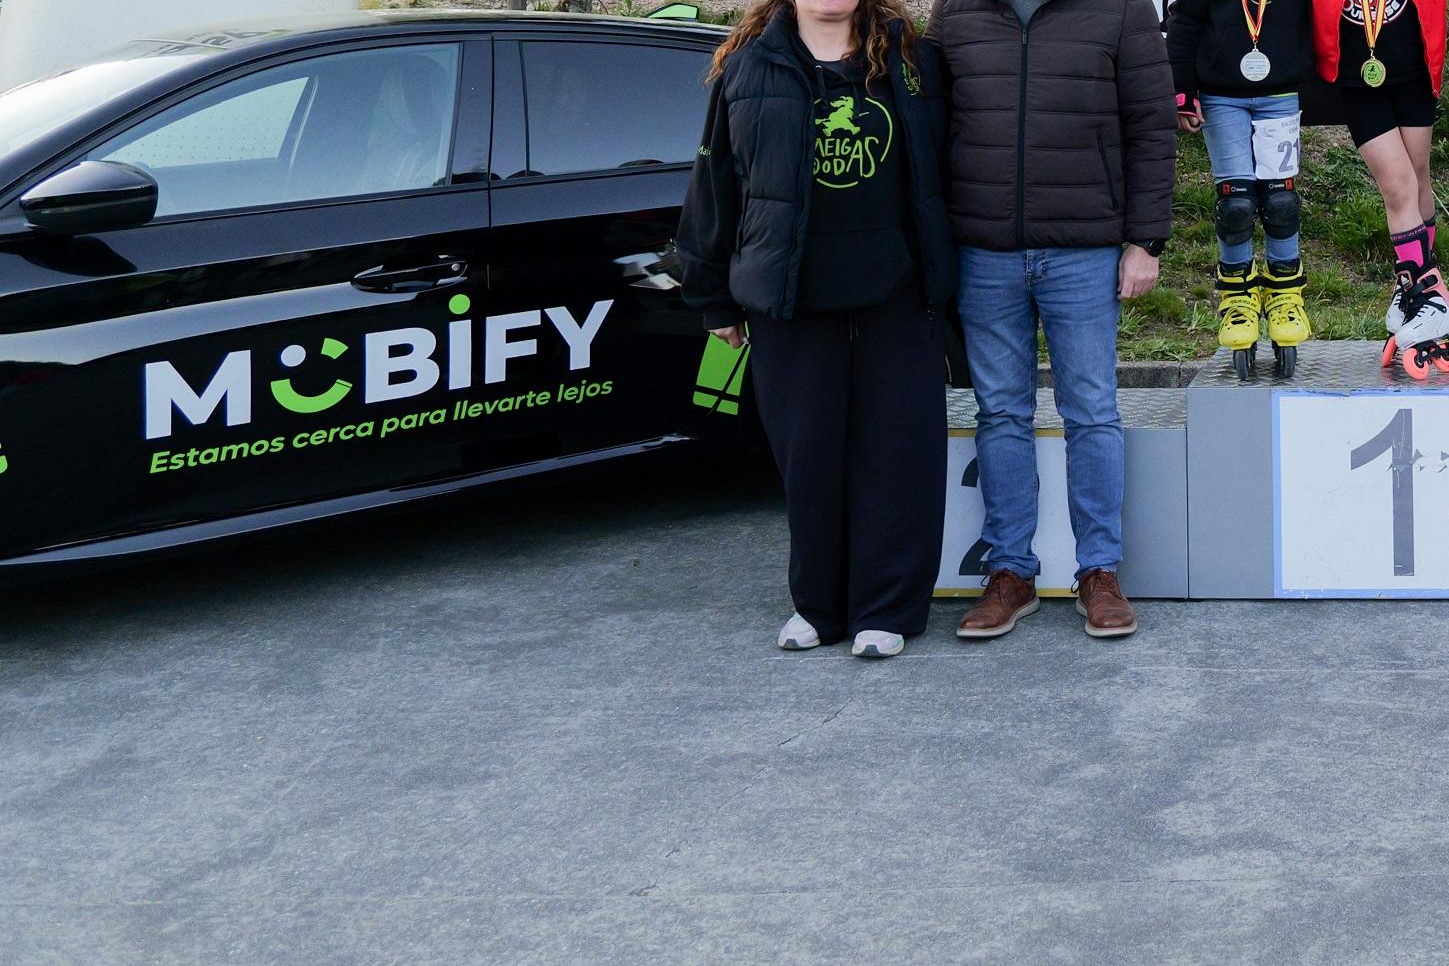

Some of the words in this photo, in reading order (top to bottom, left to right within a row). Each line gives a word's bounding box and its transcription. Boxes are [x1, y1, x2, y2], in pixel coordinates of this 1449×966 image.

[150, 436, 285, 474] Estamos
[292, 421, 375, 449] cerca
[380, 408, 447, 438] para
[453, 389, 551, 421] llevarte
[556, 379, 614, 404] lejos
[1350, 408, 1415, 576] 1
